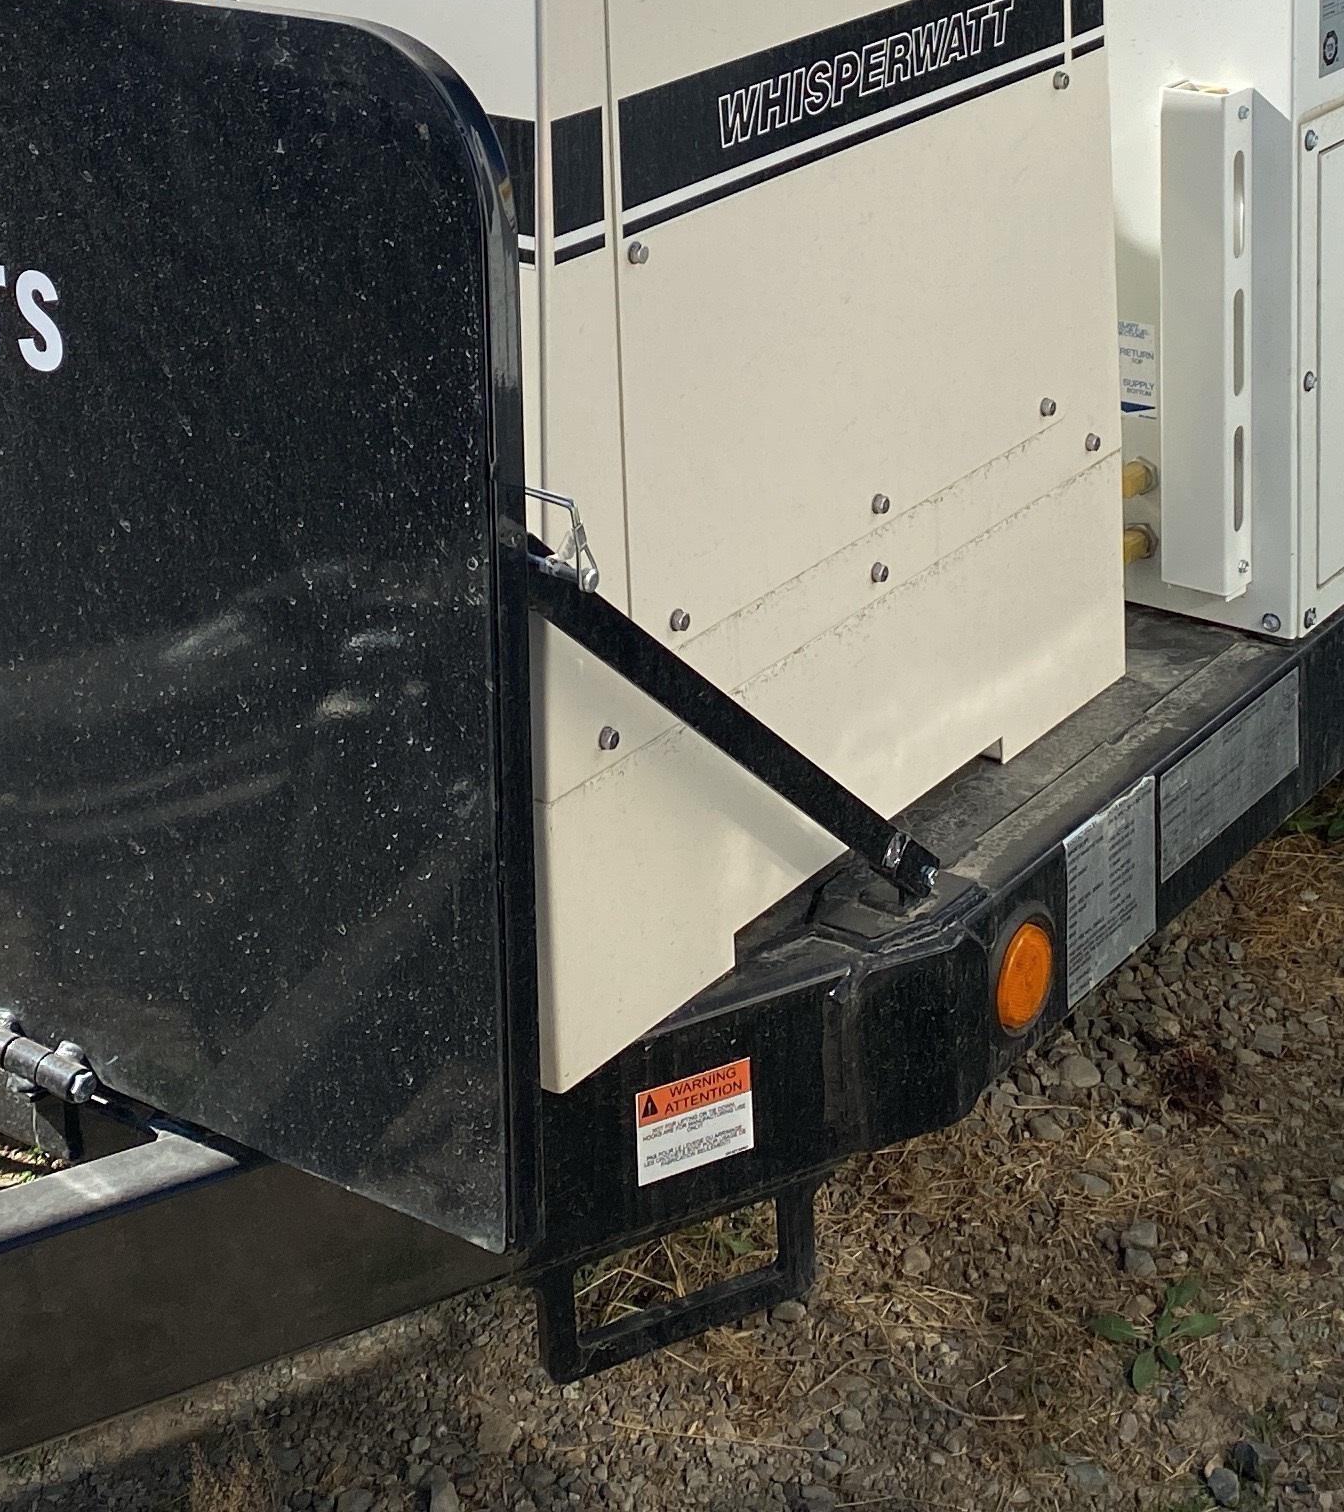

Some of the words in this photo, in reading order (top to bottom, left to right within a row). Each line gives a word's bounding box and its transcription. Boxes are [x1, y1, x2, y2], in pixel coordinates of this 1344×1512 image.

[1122, 378, 1154, 392] SUPPLY
[664, 1079, 743, 1115] ATTENTION
[669, 1066, 737, 1098] WARNING
